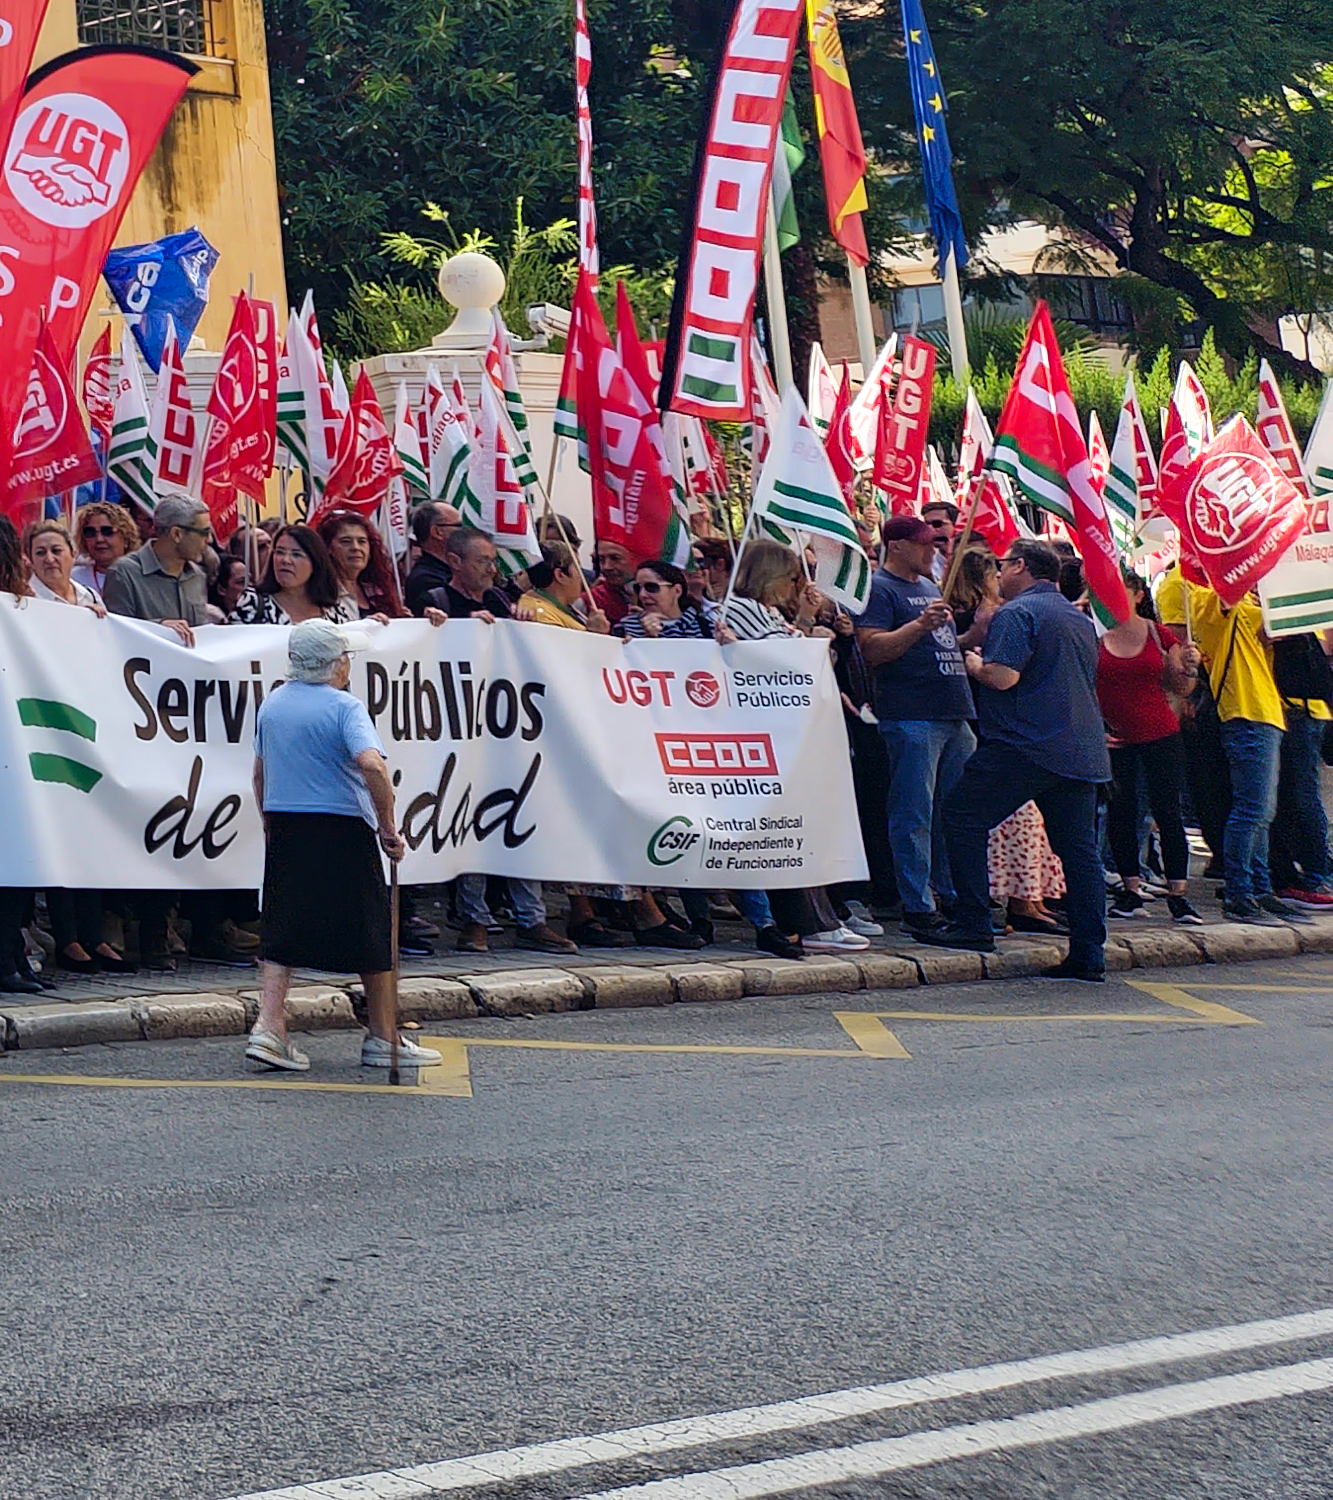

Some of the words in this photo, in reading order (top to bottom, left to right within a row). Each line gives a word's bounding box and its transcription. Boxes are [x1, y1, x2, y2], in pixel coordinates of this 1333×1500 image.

[35, 105, 126, 169] UGT
[895, 343, 929, 451] UGT
[602, 667, 676, 708] UGT
[733, 671, 814, 687] Servicios
[366, 661, 546, 742] Públicos
[737, 690, 811, 708] Públicos
[663, 741, 771, 768] CCOO
[669, 777, 706, 796] área
[711, 778, 783, 799] pública
[144, 754, 242, 860] de
[706, 817, 757, 832] Central
[759, 815, 803, 830] Sindical
[657, 832, 701, 851] CSIF
[708, 837, 795, 854] Independiente
[797, 838, 804, 850] y
[706, 856, 723, 870] de
[726, 855, 803, 870] Funcionarios
